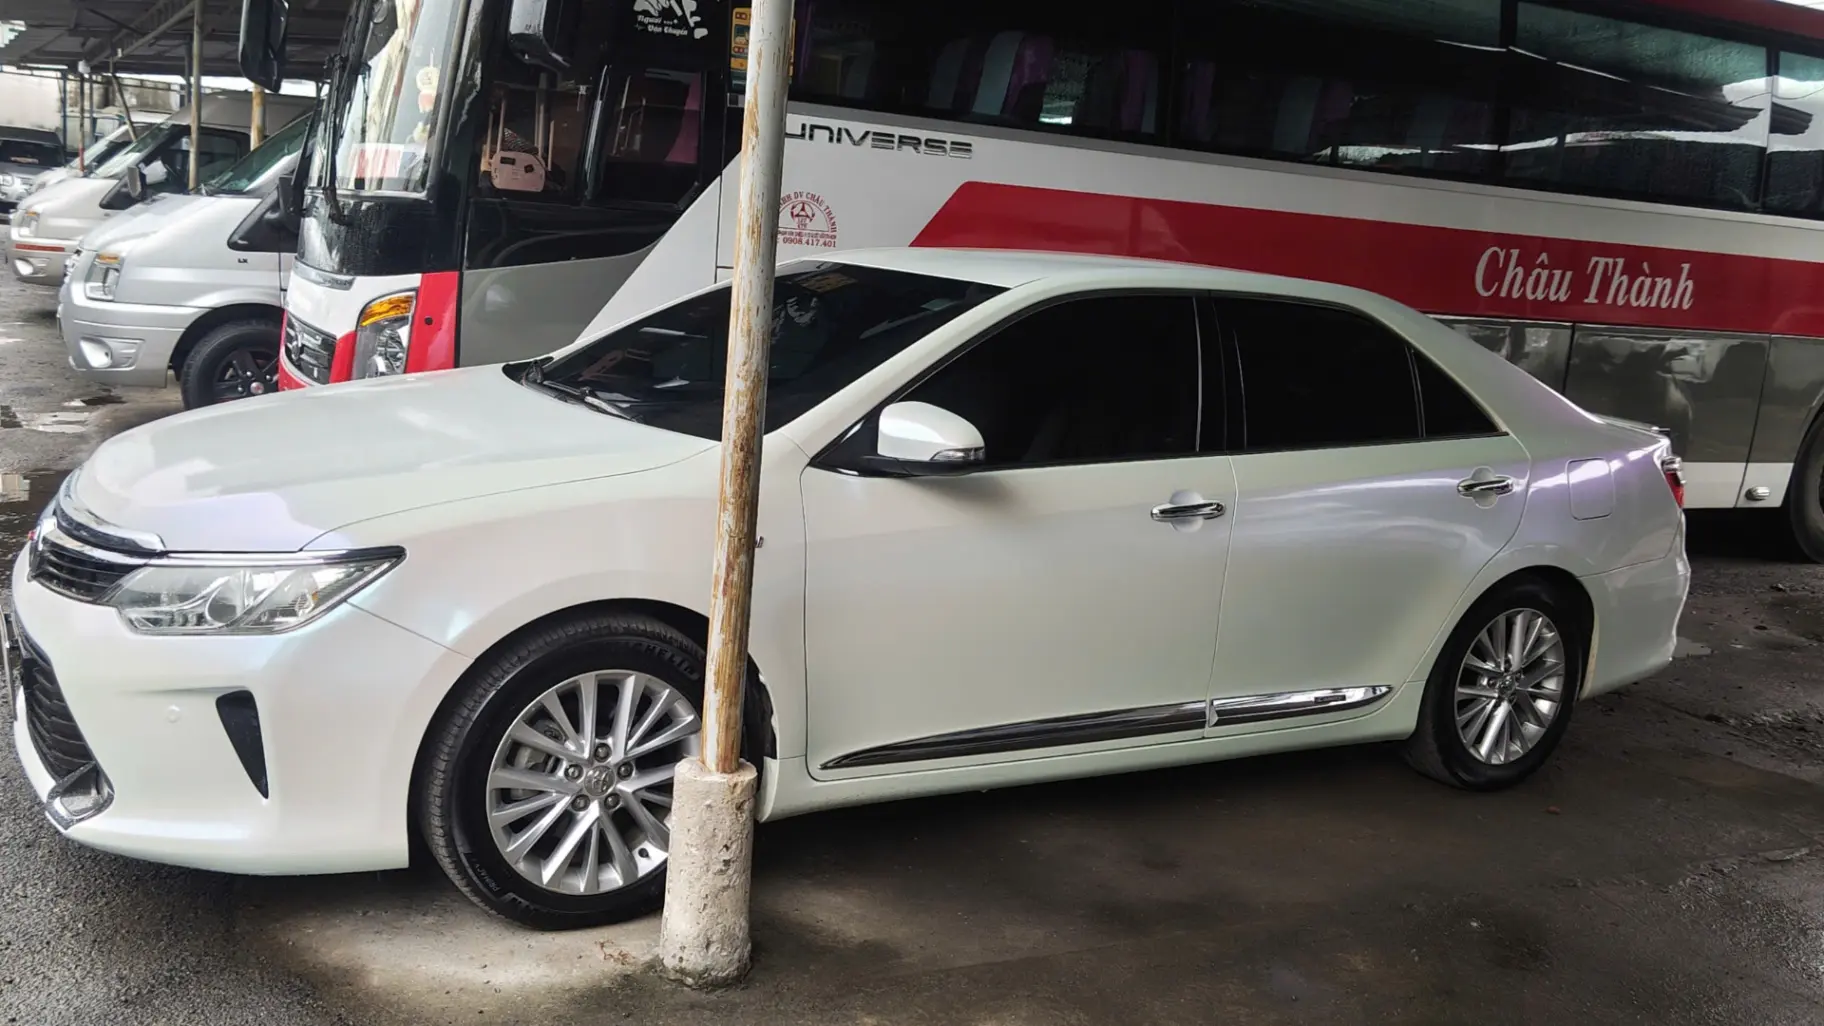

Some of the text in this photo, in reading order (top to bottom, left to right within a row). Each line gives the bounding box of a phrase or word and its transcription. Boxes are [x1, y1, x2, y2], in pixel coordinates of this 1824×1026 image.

[785, 123, 973, 160] UNIVERSE
[794, 191, 804, 200] DV
[1475, 246, 1694, 310] Châu Thành
